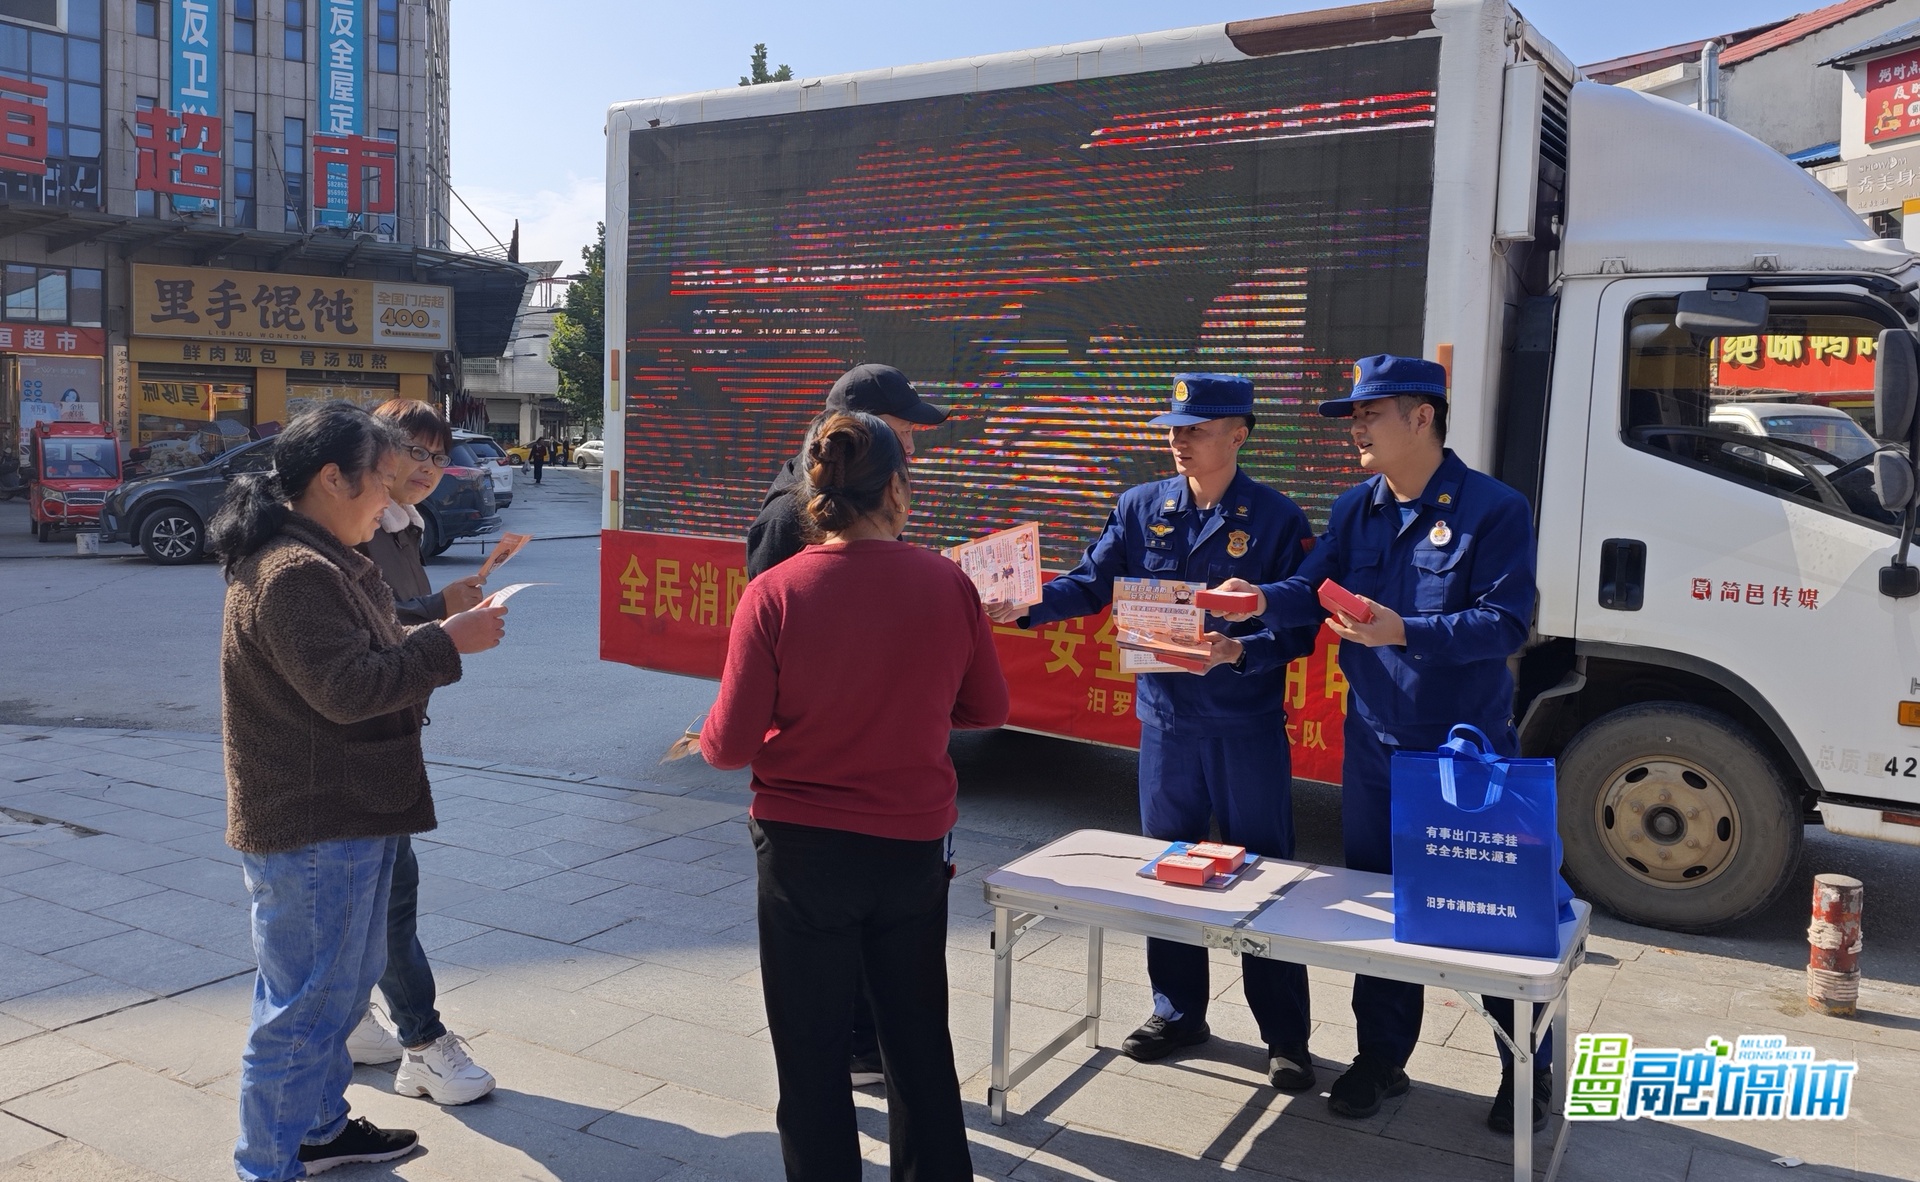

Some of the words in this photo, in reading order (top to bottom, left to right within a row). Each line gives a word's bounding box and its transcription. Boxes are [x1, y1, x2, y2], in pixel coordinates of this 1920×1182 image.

[180, 0, 209, 118] 友卫
[1858, 168, 1920, 195] 秀美身
[150, 278, 358, 335] 里手馄饨
[377, 291, 445, 309] 全国门店超
[380, 307, 430, 328] 400
[208, 330, 252, 338] LISHOU
[259, 332, 308, 340] WONTON
[182, 344, 278, 364] 鲜肉现包
[300, 350, 388, 369] 骨汤现熬
[1720, 581, 1820, 611] 简邑传媒
[1425, 826, 1518, 848] 有事出门无牵挂
[1425, 843, 1518, 865] 安全先把火源查
[1426, 896, 1518, 919] 汨罗市消防救援大队
